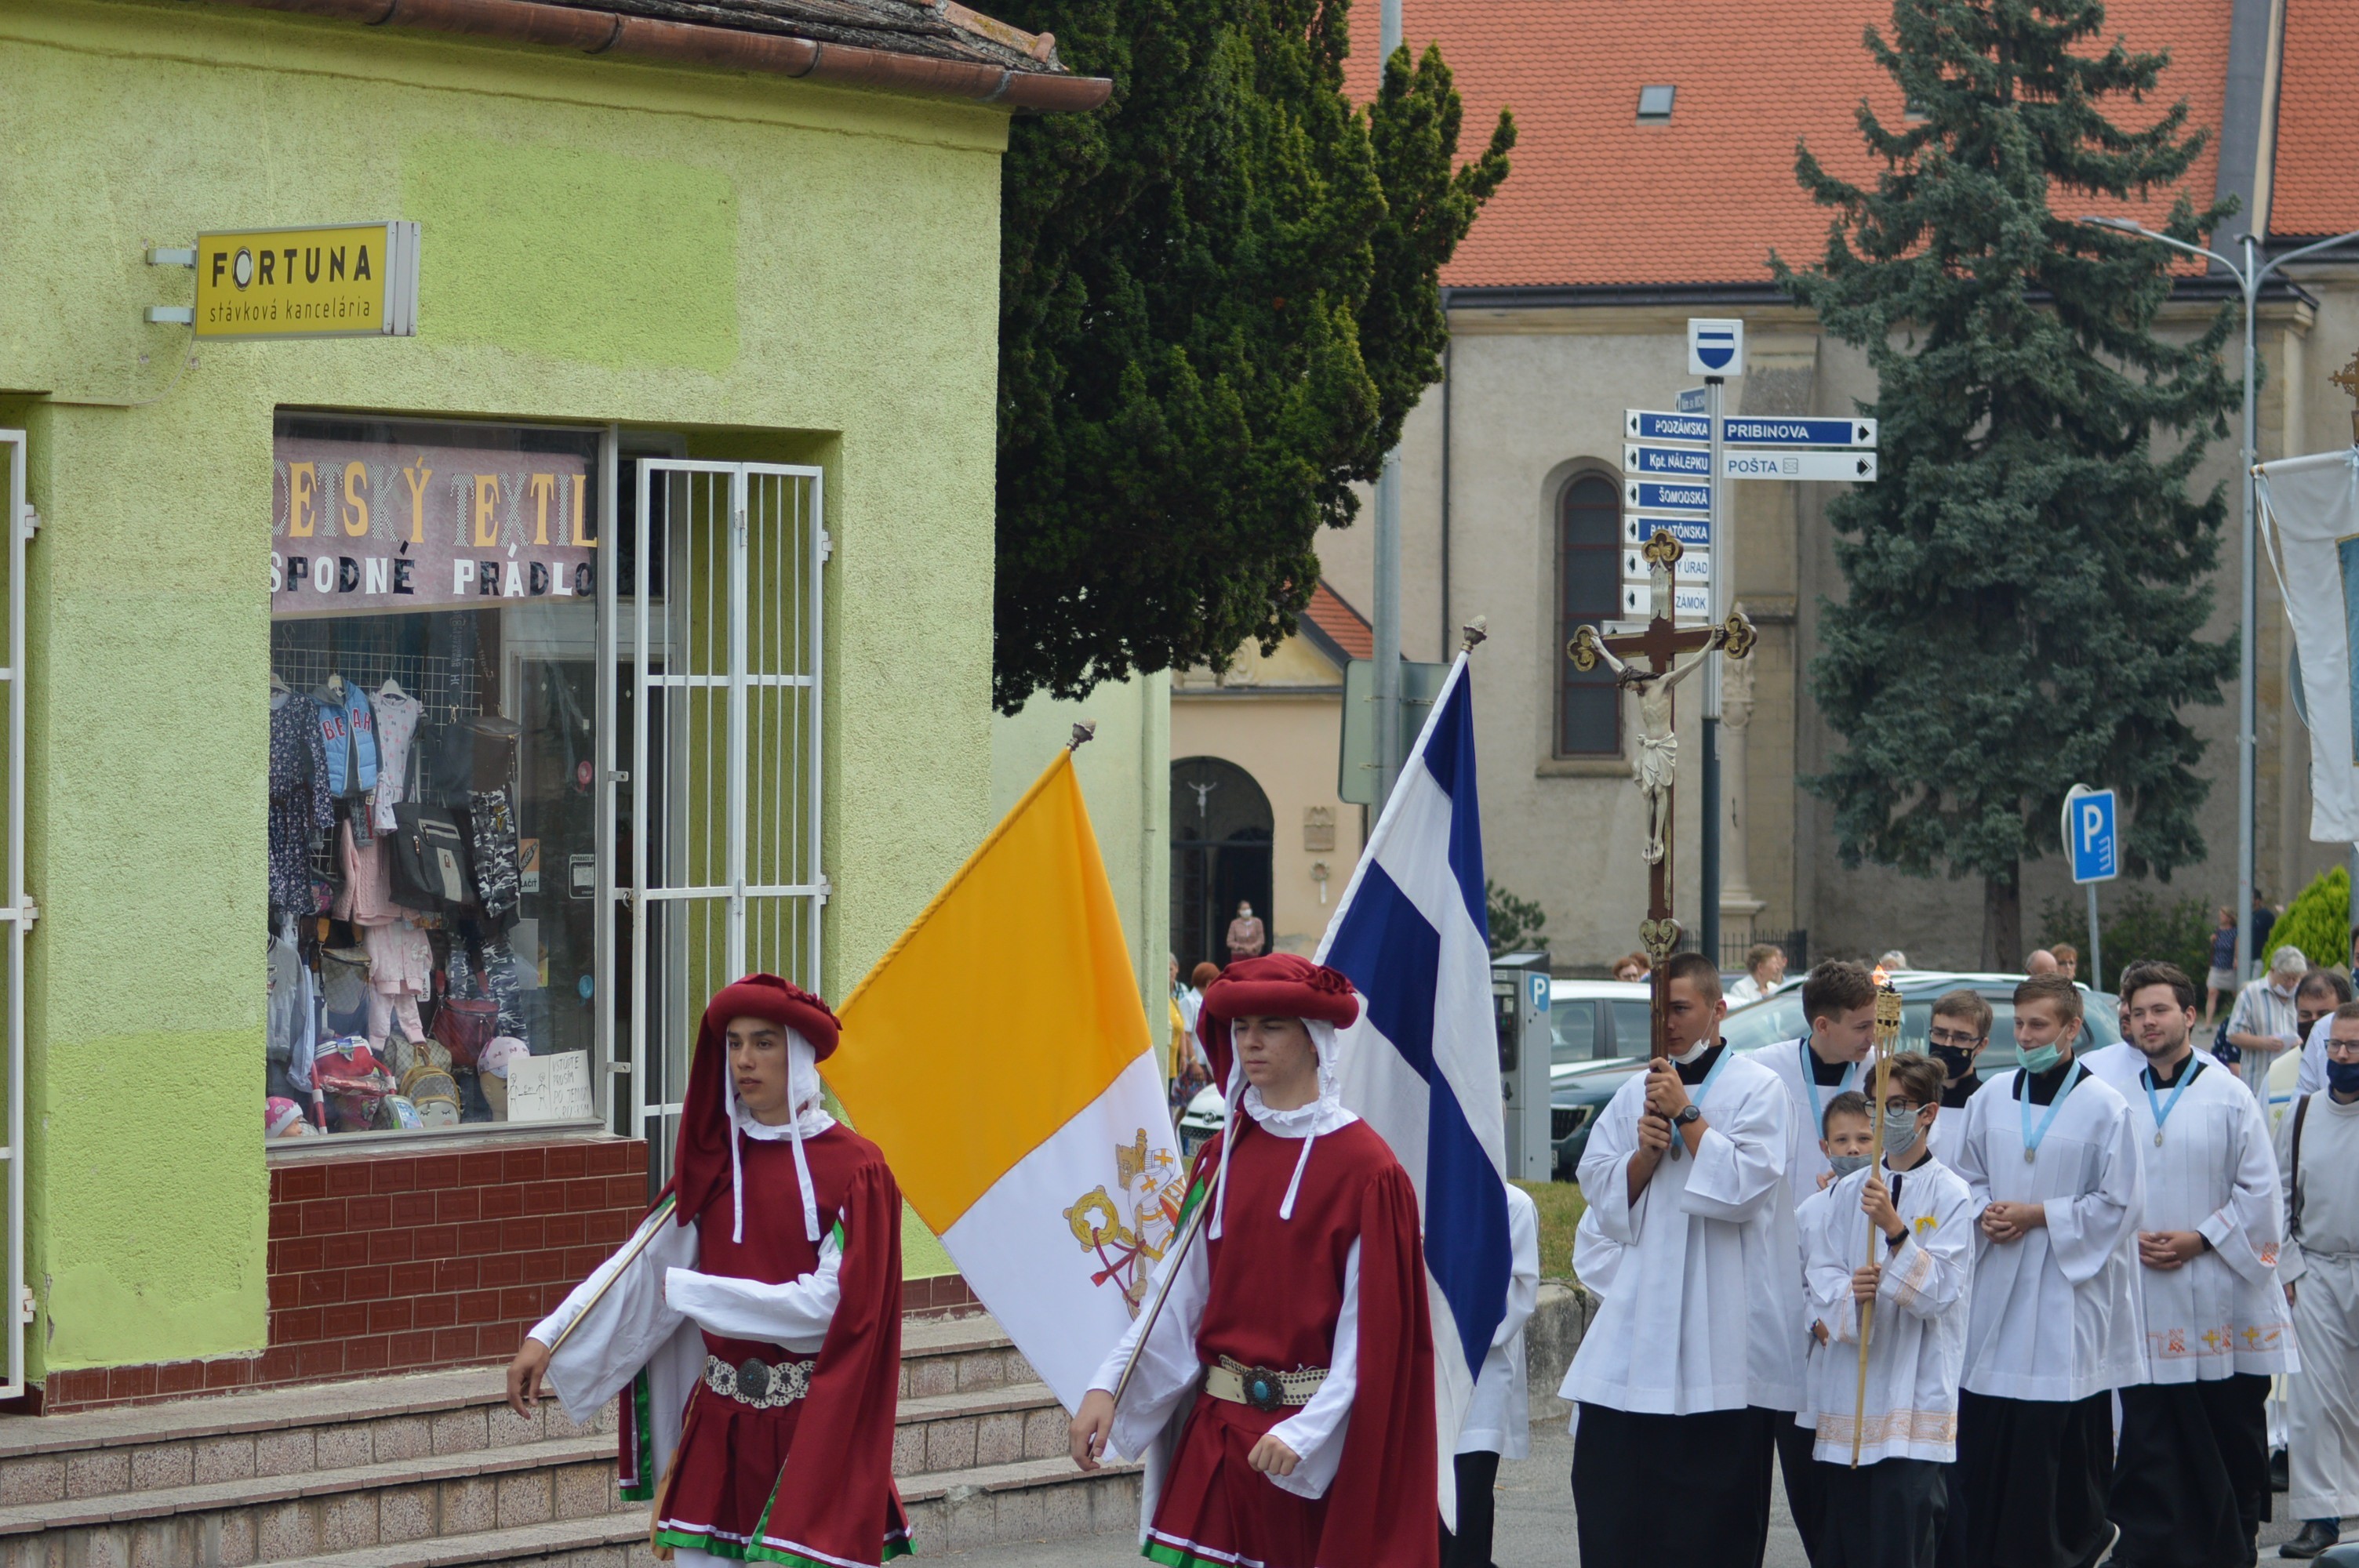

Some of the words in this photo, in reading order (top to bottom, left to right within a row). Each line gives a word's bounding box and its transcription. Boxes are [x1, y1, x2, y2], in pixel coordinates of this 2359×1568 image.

[212, 245, 372, 292] FORTUNA
[210, 299, 277, 322] stávková
[286, 296, 370, 319] kancelária
[1655, 418, 1708, 436] PODZÁMSKA
[1727, 424, 1809, 439] PRIBINOVA
[1649, 453, 1666, 470] Kpt.
[1667, 452, 1708, 470] NÁLEPKU
[1728, 458, 1778, 473] POŠTA
[1659, 486, 1708, 505] ŠOMODSKÁ
[449, 472, 598, 547] TEXTIL
[271, 540, 416, 595] SPODNÉ
[453, 543, 593, 597] PRÁDLO
[1684, 557, 1708, 574] ÚRAD
[1675, 593, 1707, 609] ZÁMOK
[322, 707, 372, 741] BEAR
[2083, 804, 2103, 853] P
[520, 878, 537, 887] LAČIŤ
[1533, 978, 1547, 1005] P
